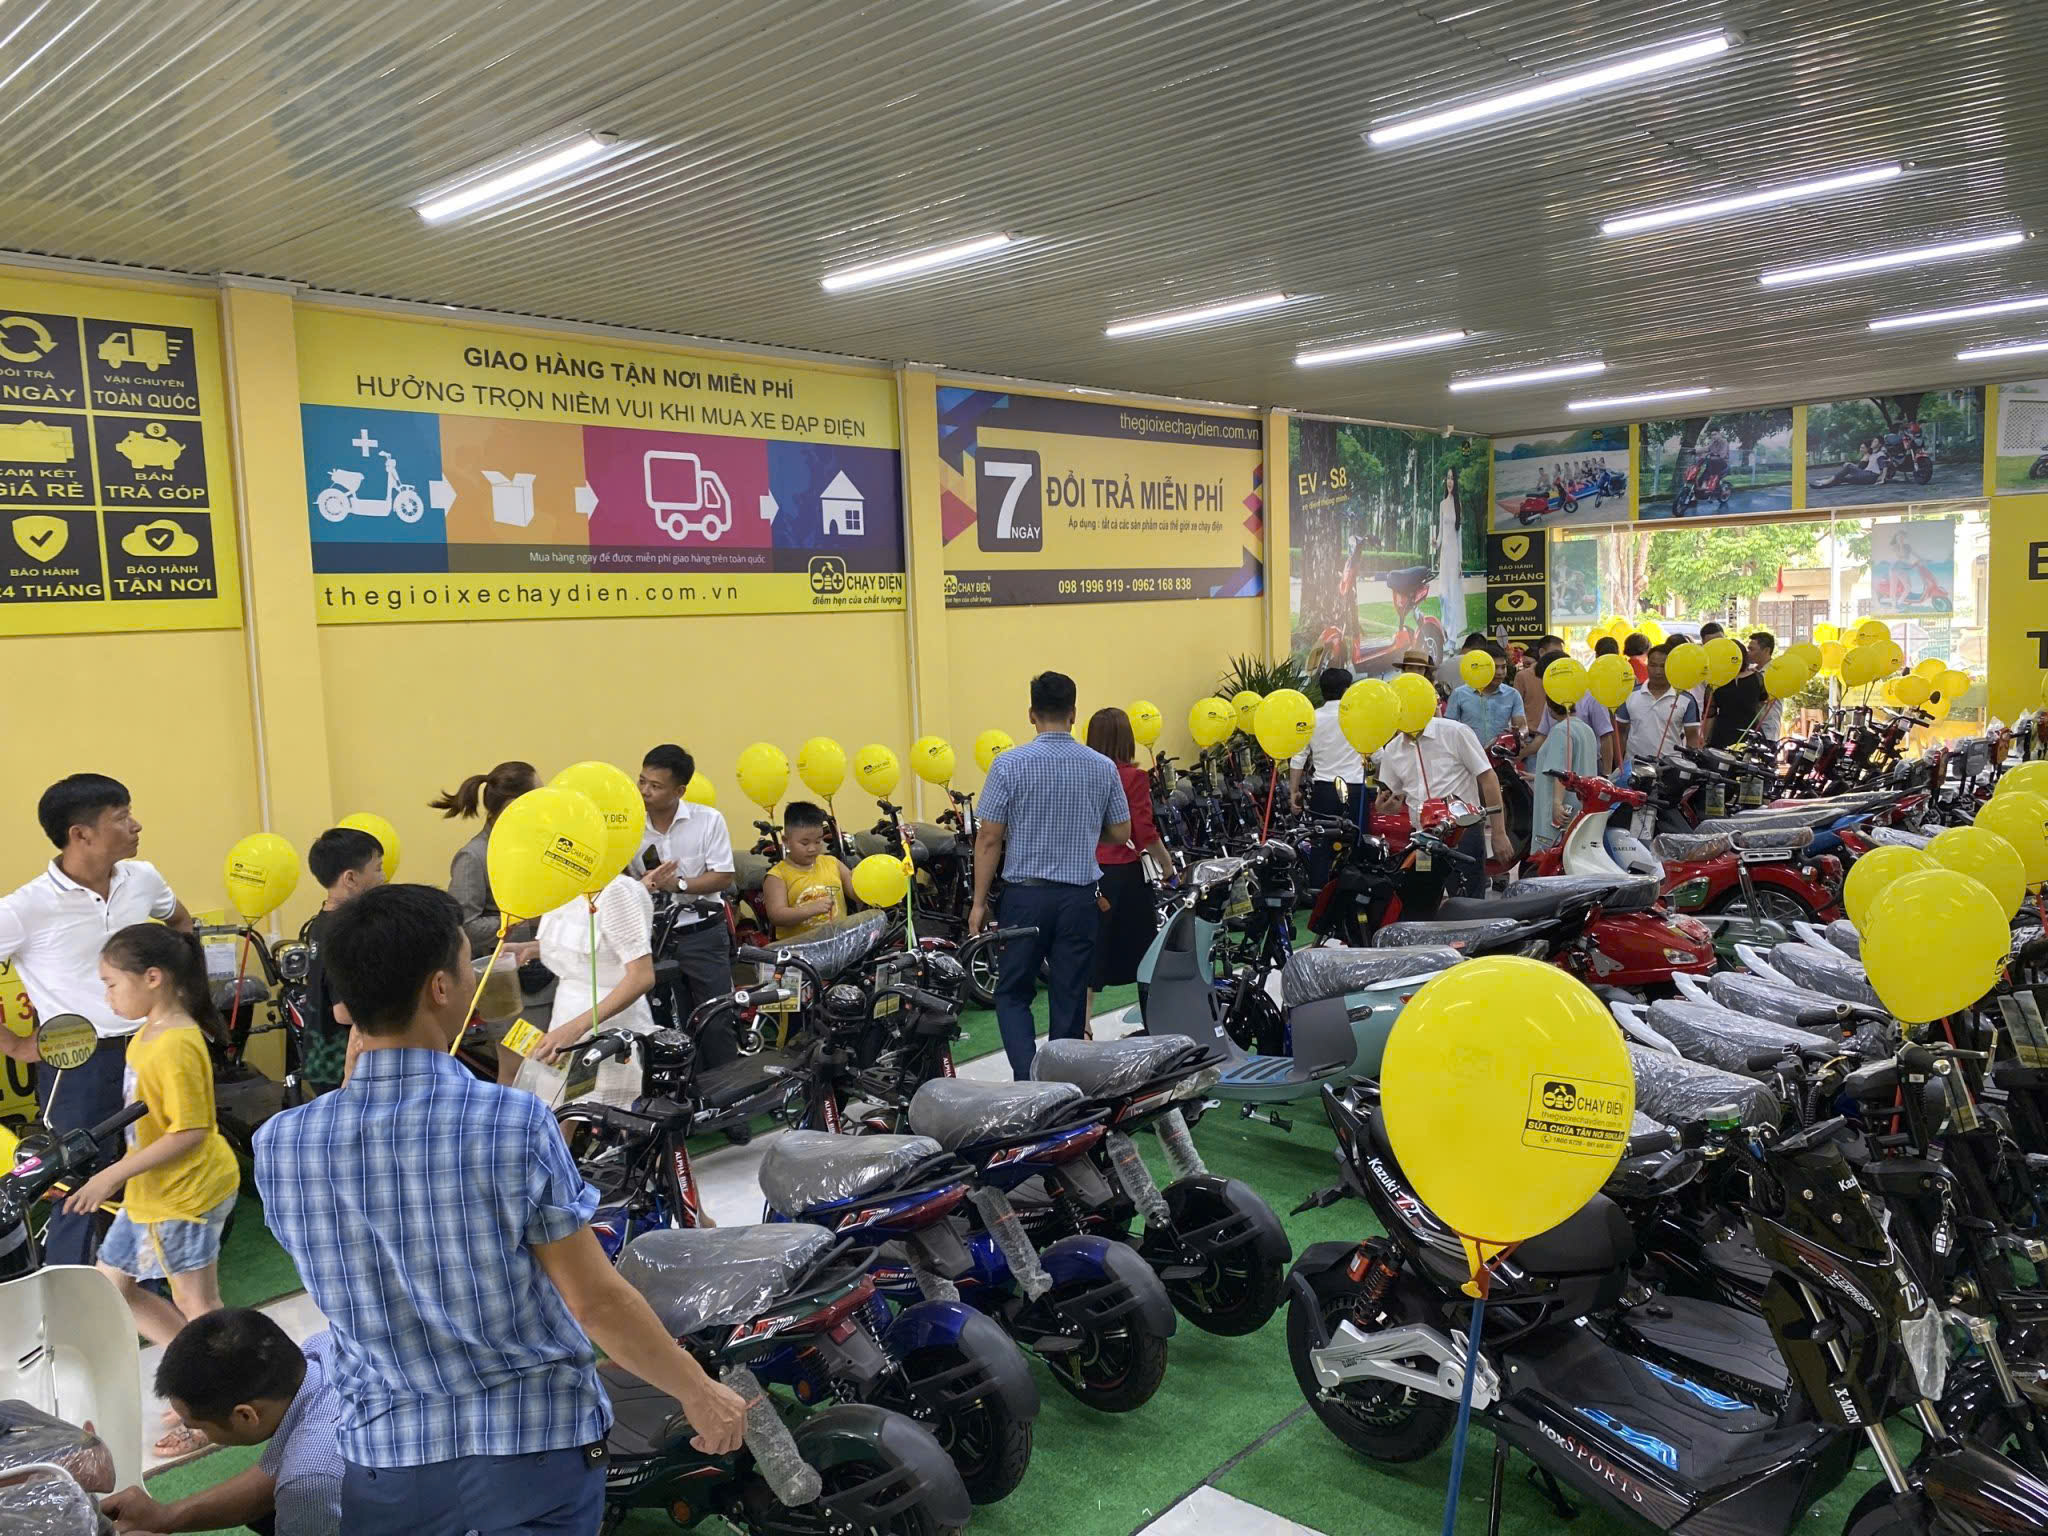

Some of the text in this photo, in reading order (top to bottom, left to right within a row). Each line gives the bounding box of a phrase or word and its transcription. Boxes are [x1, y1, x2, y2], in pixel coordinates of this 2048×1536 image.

[464, 347, 794, 400] GIAO HÀNG TẬN NƠI MIỄN PHÍ
[3, 384, 76, 402] NGÀY
[93, 388, 196, 409] TOÀN QUỐC
[356, 374, 866, 439] HƯỞNG TRỌN NIỀM VUI KHI MUA XE ĐẠP ĐIỆN
[1119, 412, 1260, 441] thegioixechaydien.com.vn
[46, 481, 85, 498] RẺ
[1298, 472, 1317, 496] EV
[1330, 466, 1347, 489] S8
[105, 483, 205, 500] TRẢ GÓP
[984, 461, 1032, 539] 7
[1046, 470, 1224, 512] ĐỔI TRẢ MIỄN PHÍ
[1011, 524, 1040, 540] NGÀY
[529, 552, 550, 562] Mua
[552, 551, 574, 565] hàng
[577, 553, 597, 565] ngay
[846, 573, 902, 593] CHẠY ĐIỆN
[1058, 580, 1077, 594] 098
[1080, 579, 1104, 593] 1996
[1106, 579, 1124, 592] 919
[1132, 578, 1154, 592] 0962
[1157, 578, 1173, 591] 168
[1175, 577, 1191, 590] 838
[1504, 571, 1544, 581] THÁNG
[0, 582, 102, 599] 4 THÁNG
[114, 577, 212, 596] TẬN NƠI
[325, 583, 738, 610] thegioixechaydien.com.vn
[1490, 623, 1543, 633] TN NƠI
[1577, 1097, 1605, 1115] CHẠY
[674, 1151, 685, 1176] ALPHA
[1834, 1387, 1862, 1424] X-MEN
